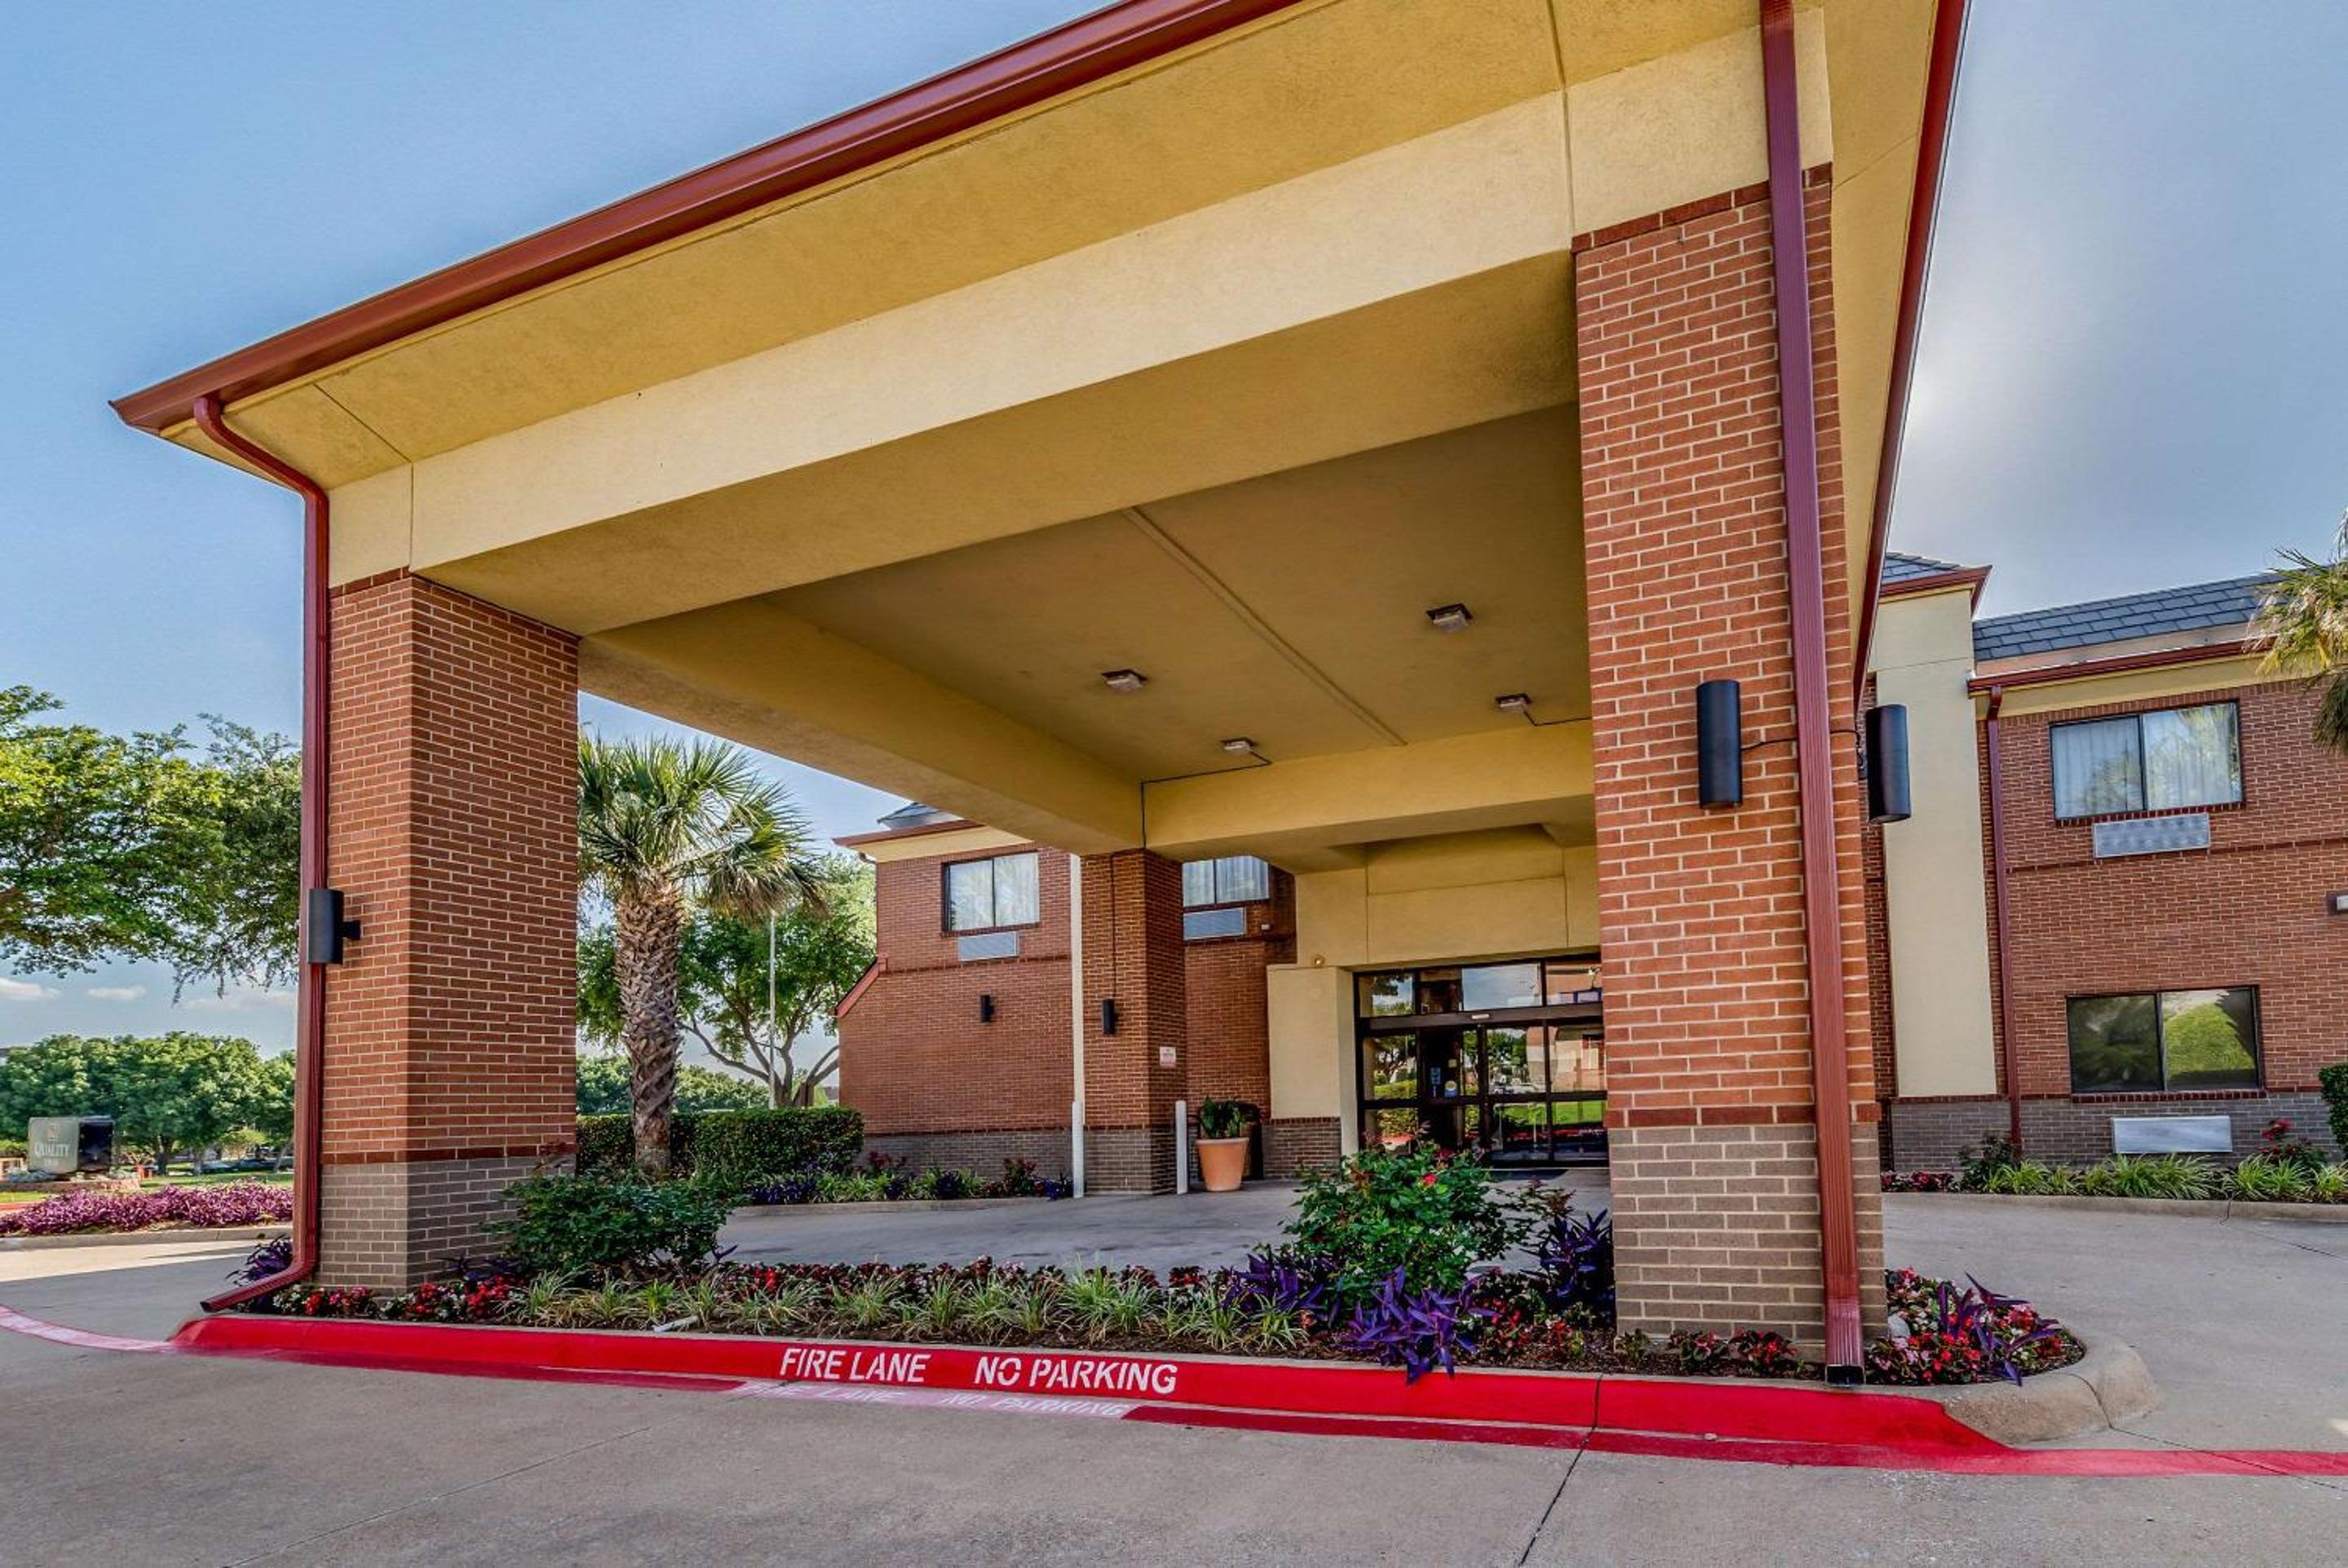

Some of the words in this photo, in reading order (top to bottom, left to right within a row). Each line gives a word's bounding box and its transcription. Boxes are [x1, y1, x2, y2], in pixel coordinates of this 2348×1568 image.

[780, 1348, 847, 1380] FIRE
[849, 1351, 931, 1383] LANE
[974, 1356, 1021, 1386] NO
[1028, 1358, 1178, 1394] PARKING
